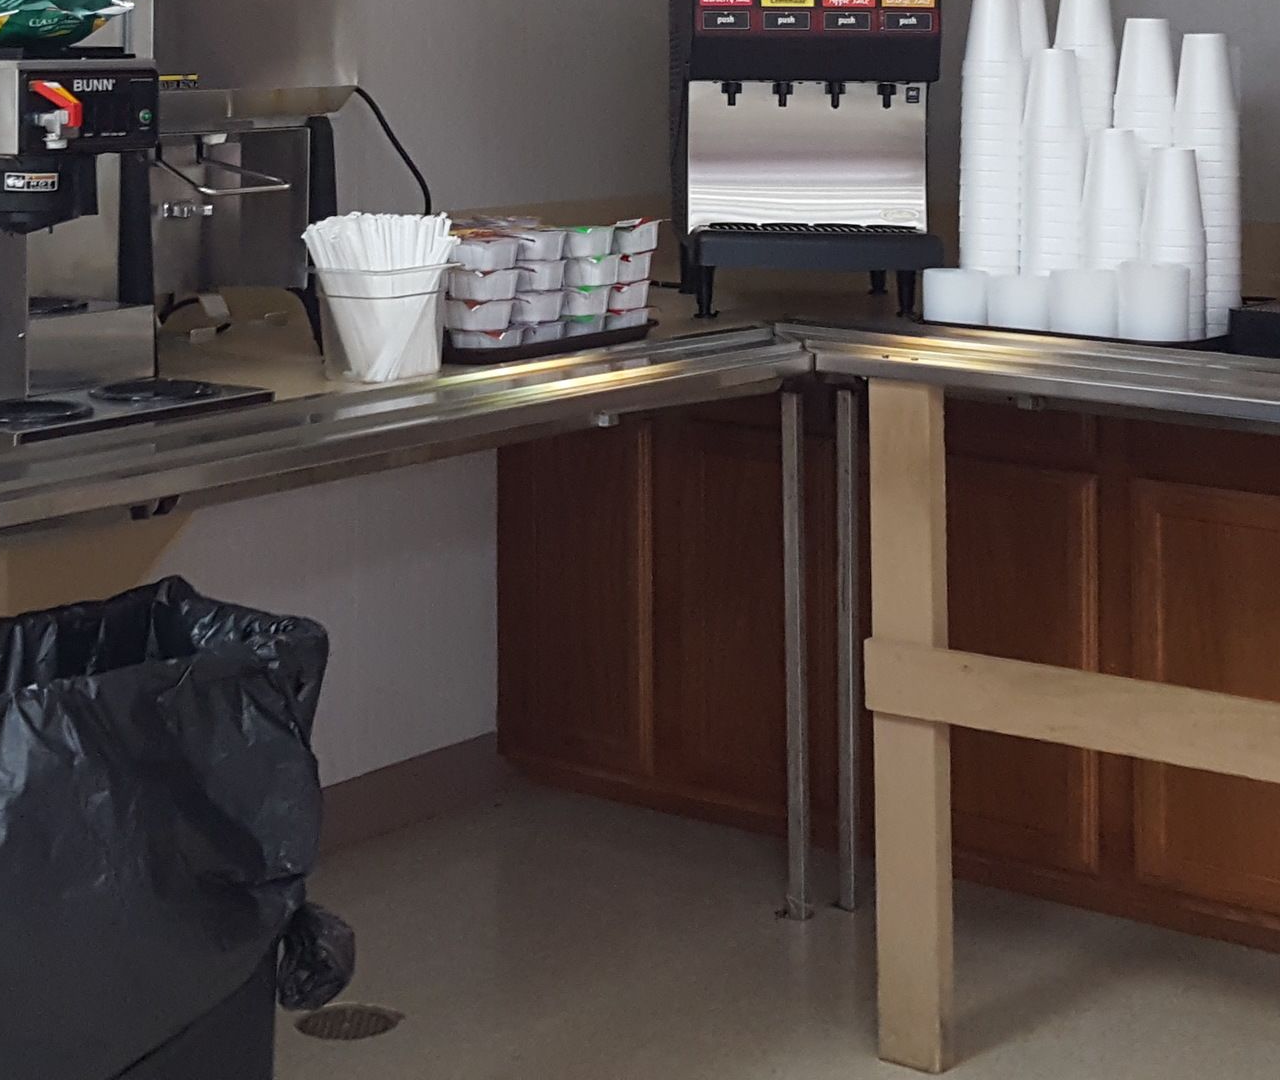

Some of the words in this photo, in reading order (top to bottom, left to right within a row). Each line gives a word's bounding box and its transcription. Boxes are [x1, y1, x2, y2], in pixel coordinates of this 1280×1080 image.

[717, 15, 735, 25] push
[778, 16, 796, 26] push
[838, 16, 856, 26] push
[899, 16, 918, 27] push
[73, 78, 114, 92] BUNN
